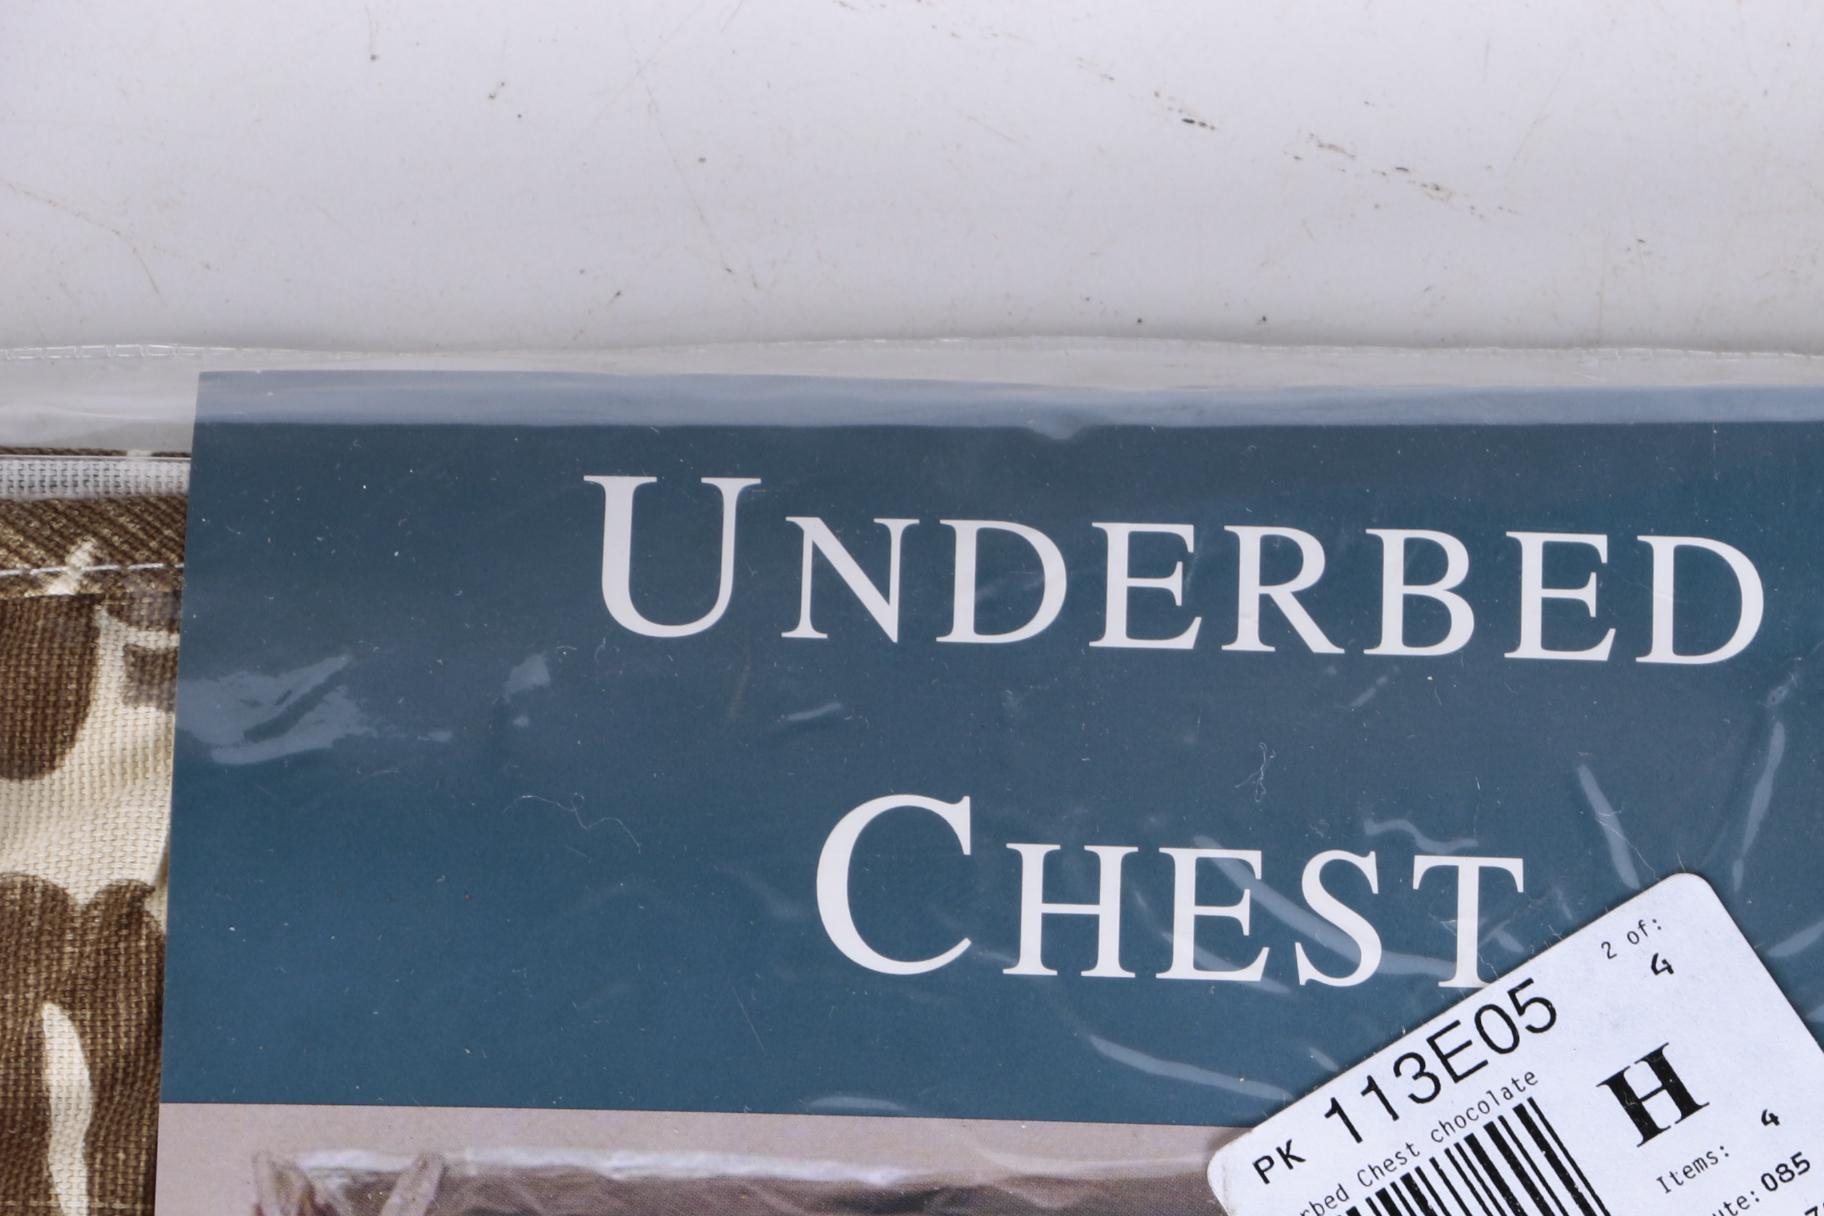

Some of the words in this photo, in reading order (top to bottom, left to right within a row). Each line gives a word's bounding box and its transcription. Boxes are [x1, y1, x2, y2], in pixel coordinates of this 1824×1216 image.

[1601, 941, 1617, 959] 2
[1627, 918, 1662, 946] of:
[1651, 953, 1674, 976] 4
[1252, 1139, 1306, 1185] PK
[1324, 978, 1557, 1144] 113E05
[1596, 1043, 1709, 1147] H
[1357, 1142, 1420, 1188] Chest
[1430, 1070, 1538, 1144] chocolate
[1657, 1145, 1730, 1193] Items:
[1761, 1109, 1780, 1126] 4
